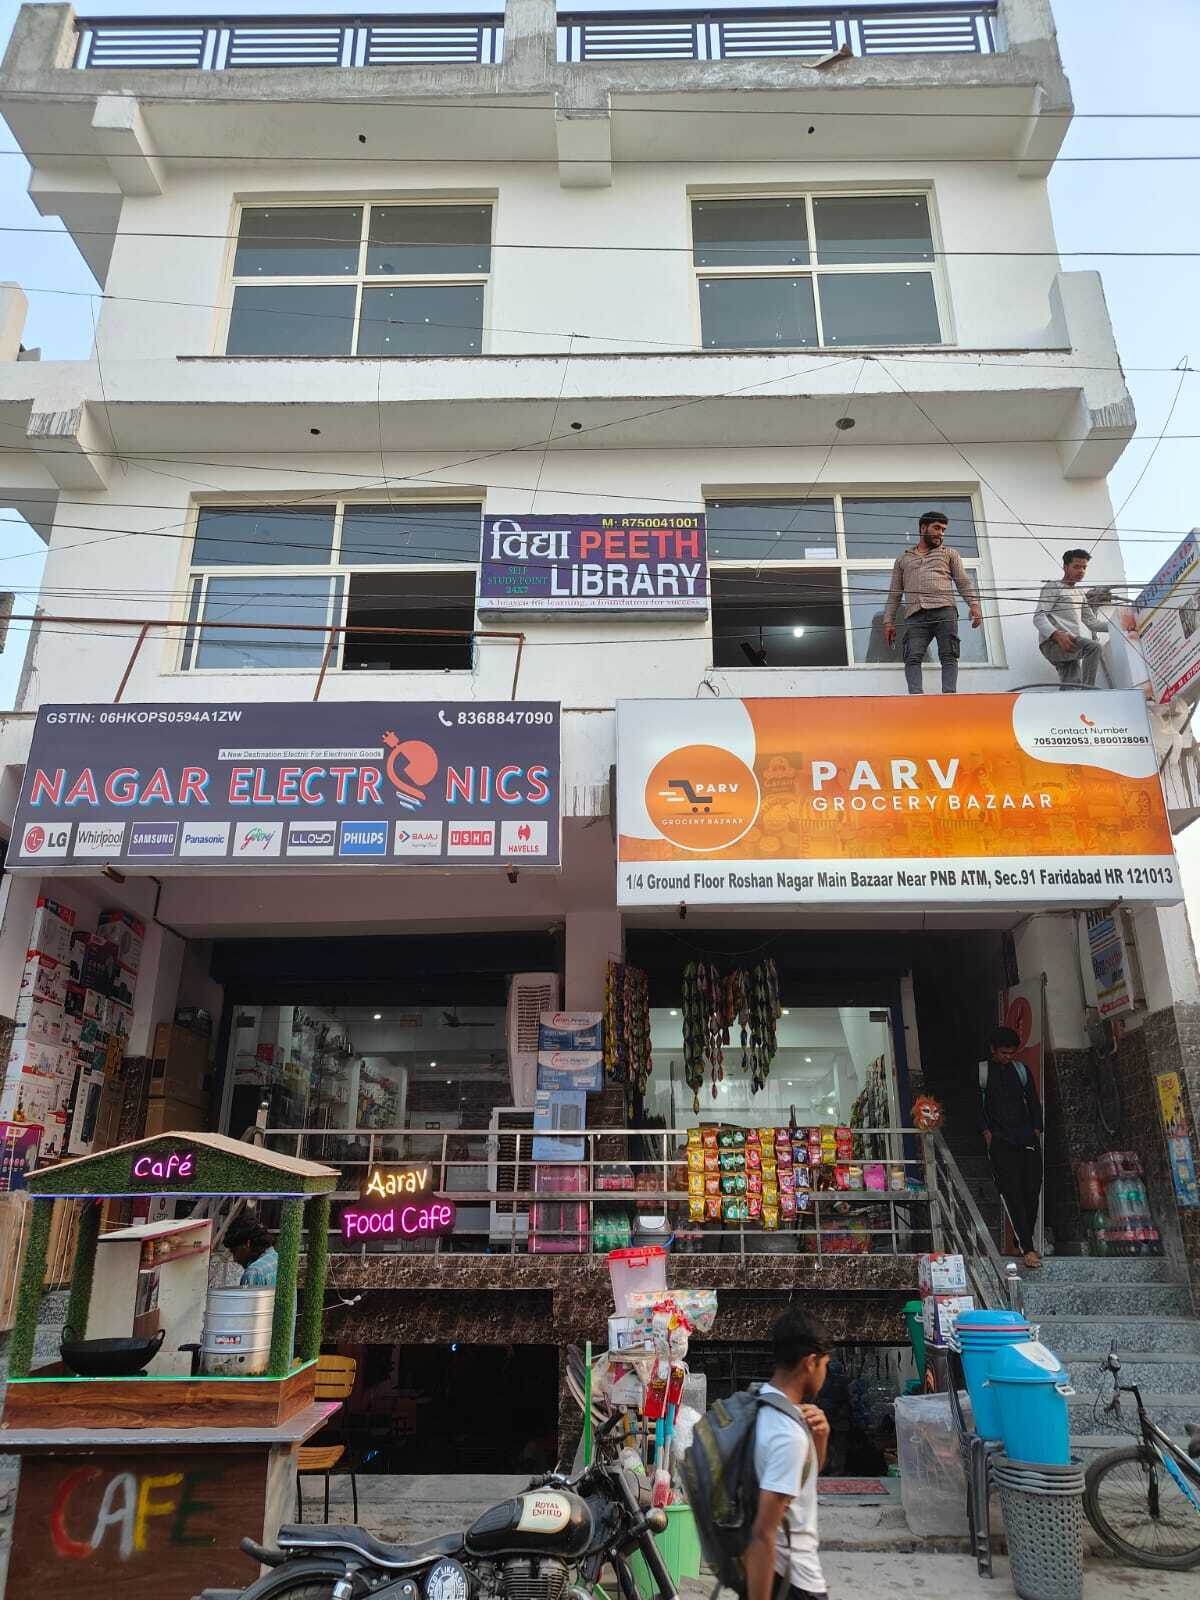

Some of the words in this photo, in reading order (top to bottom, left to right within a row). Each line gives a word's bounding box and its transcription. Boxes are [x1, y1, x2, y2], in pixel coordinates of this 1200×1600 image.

[621, 518, 698, 528] 8750041001
[490, 519, 572, 560] विद्या
[579, 531, 699, 559] PEETH
[550, 563, 701, 596] LIBRARY
[47, 712, 95, 723] GSTIN:
[100, 711, 241, 723] 06HKOPS0594A1ZW
[457, 712, 553, 725] 8368847090
[1034, 737, 1092, 745] 7053012053,
[811, 759, 960, 791] PARV
[30, 768, 210, 807] NAGAR
[696, 784, 738, 793] PARV
[813, 796, 937, 811] GROCERY
[949, 794, 1053, 810] BAZAAR
[48, 832, 67, 848] LG
[78, 828, 123, 849] Whirlpool
[132, 833, 174, 844] SAMSUNG
[184, 834, 225, 844] Panasonic
[343, 832, 384, 845] PHILIPS
[452, 832, 492, 845] USHA
[508, 845, 539, 853] HAVELLS
[626, 873, 644, 890] 1/4
[647, 873, 690, 889] Ground
[694, 873, 725, 889] Floor
[729, 873, 773, 889] Roshan
[777, 873, 814, 892] Nagar
[818, 873, 847, 888] Main
[851, 872, 893, 887] Bazaar
[898, 871, 926, 887] Near
[931, 870, 957, 886] PNB
[961, 870, 992, 889] ATM,
[995, 869, 1036, 885] Sec.91
[1040, 868, 1101, 885] Faridabad
[1105, 868, 1124, 884] HR
[1127, 867, 1173, 884] 121013
[134, 1154, 193, 1178] Café
[365, 1168, 428, 1198] Aarav
[344, 1208, 394, 1238] Food
[401, 1205, 451, 1233] Cafe
[532, 1508, 562, 1518] ENFIELD
[535, 1501, 560, 1509] ROYAL
[51, 1467, 223, 1561] CAFE
